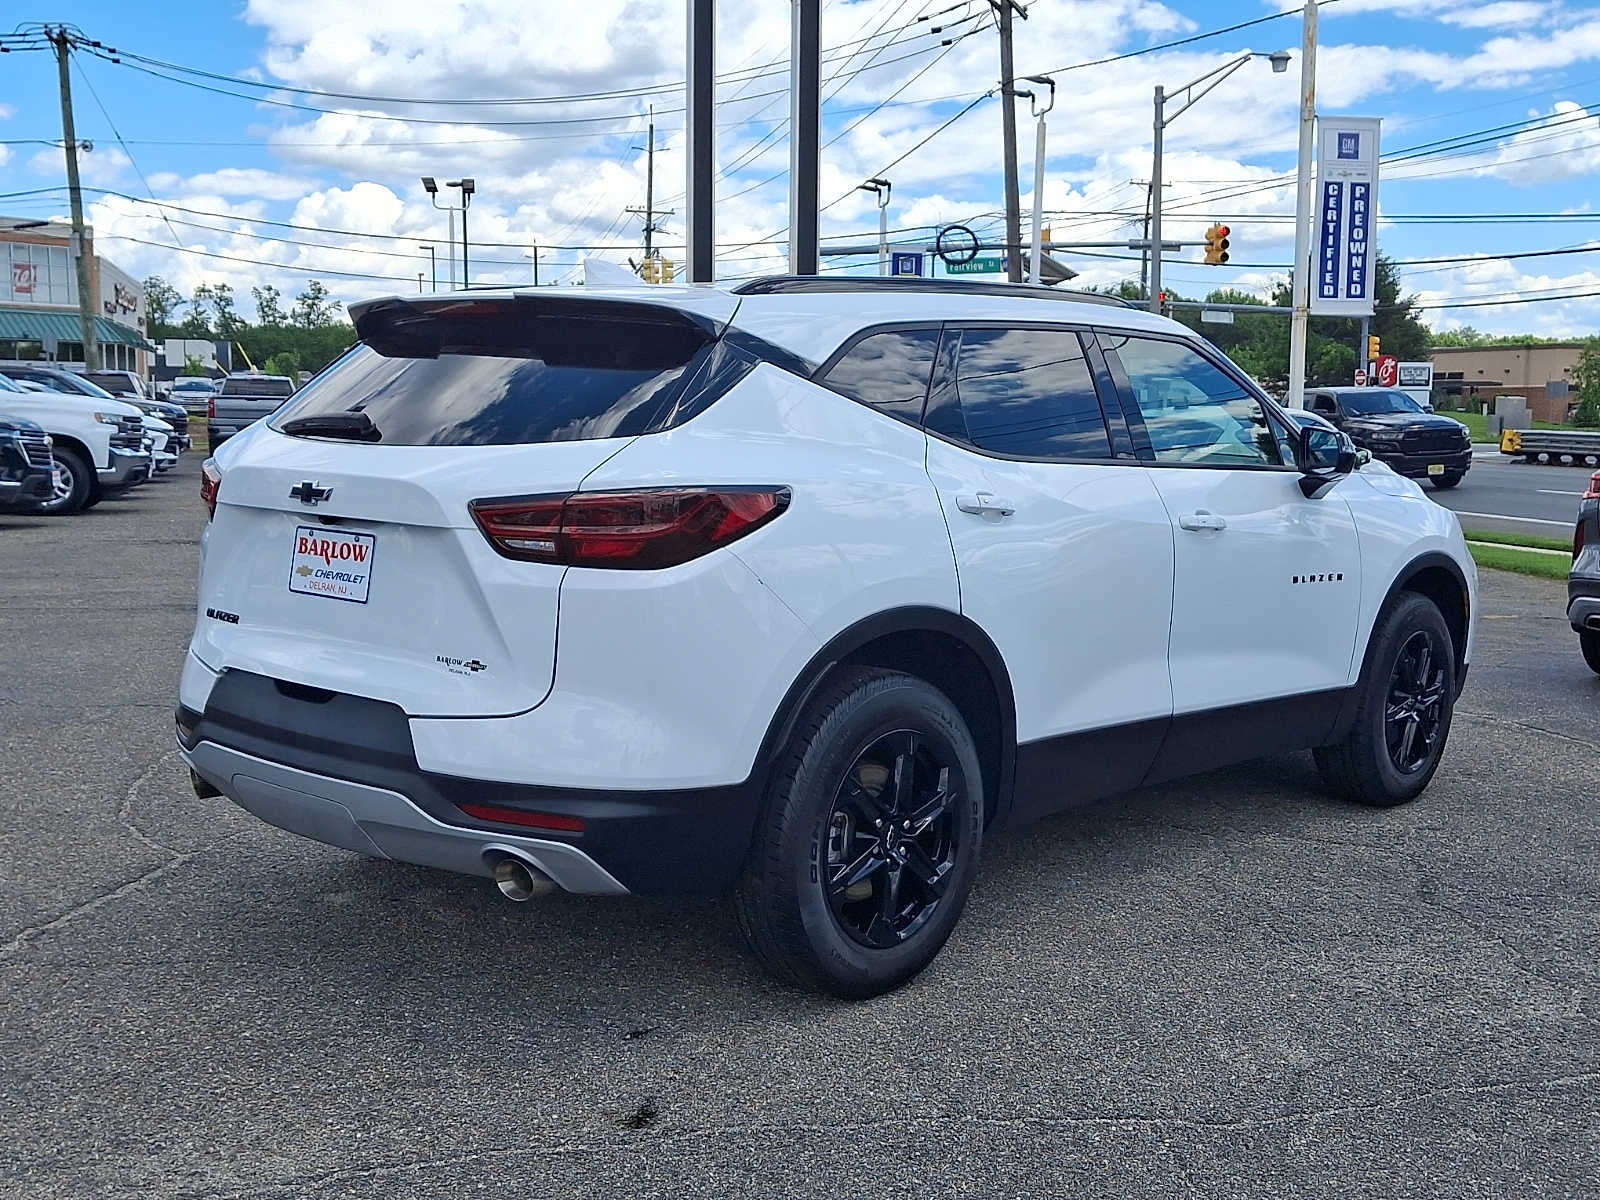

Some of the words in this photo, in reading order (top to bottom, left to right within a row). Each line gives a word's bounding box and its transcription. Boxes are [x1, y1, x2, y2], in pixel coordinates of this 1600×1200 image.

[1323, 184, 1338, 296] CERTIFIED
[1350, 185, 1366, 295] PREOWNED
[298, 537, 369, 567] BARLOW
[314, 569, 365, 584] CHEVROLET
[1292, 573, 1343, 584] BLAZER
[338, 586, 347, 595] NJ
[206, 607, 239, 625] BLAZER
[436, 655, 463, 667] BARLOW
